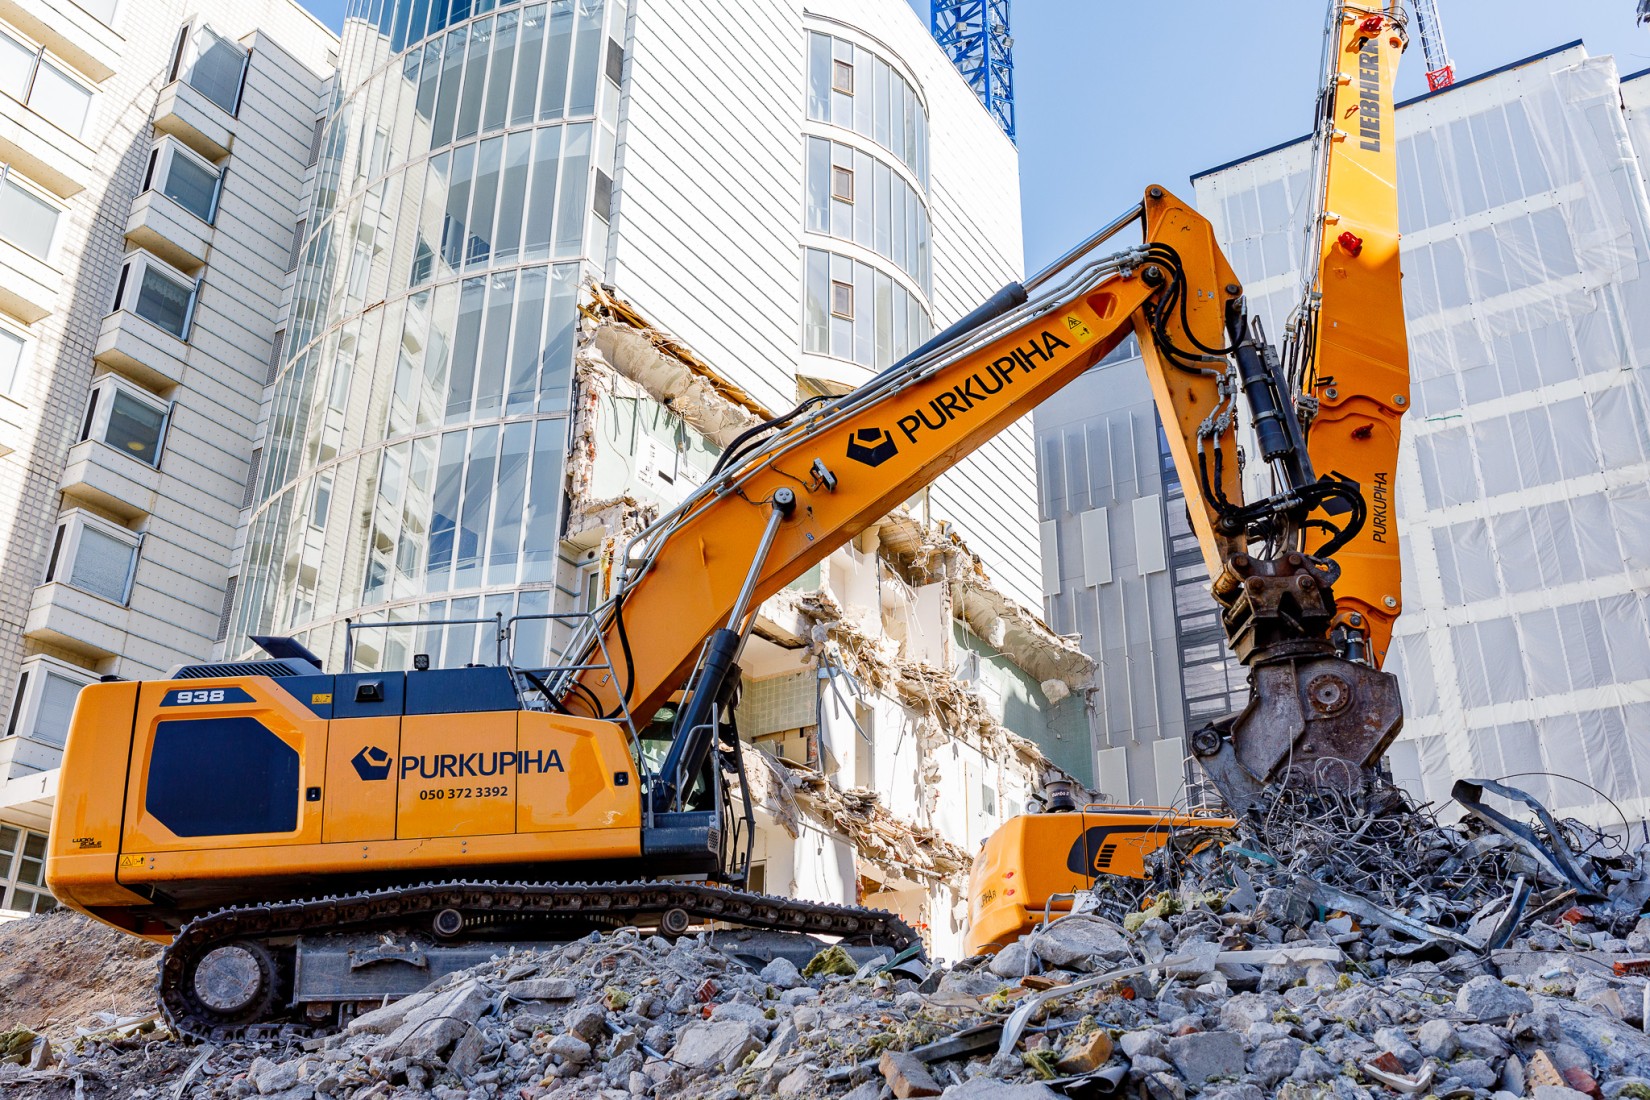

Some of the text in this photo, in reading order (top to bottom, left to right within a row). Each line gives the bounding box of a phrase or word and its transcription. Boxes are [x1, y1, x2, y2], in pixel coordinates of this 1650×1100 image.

[1359, 36, 1380, 153] LIEBHERR
[896, 330, 1070, 444] PURKUPIHA
[1373, 472, 1387, 544] PURKUPIHA
[177, 690, 224, 704] 938
[401, 749, 565, 780] PURKUPIHA
[41, 776, 48, 794] 1
[419, 786, 508, 801] 050 372 3392
